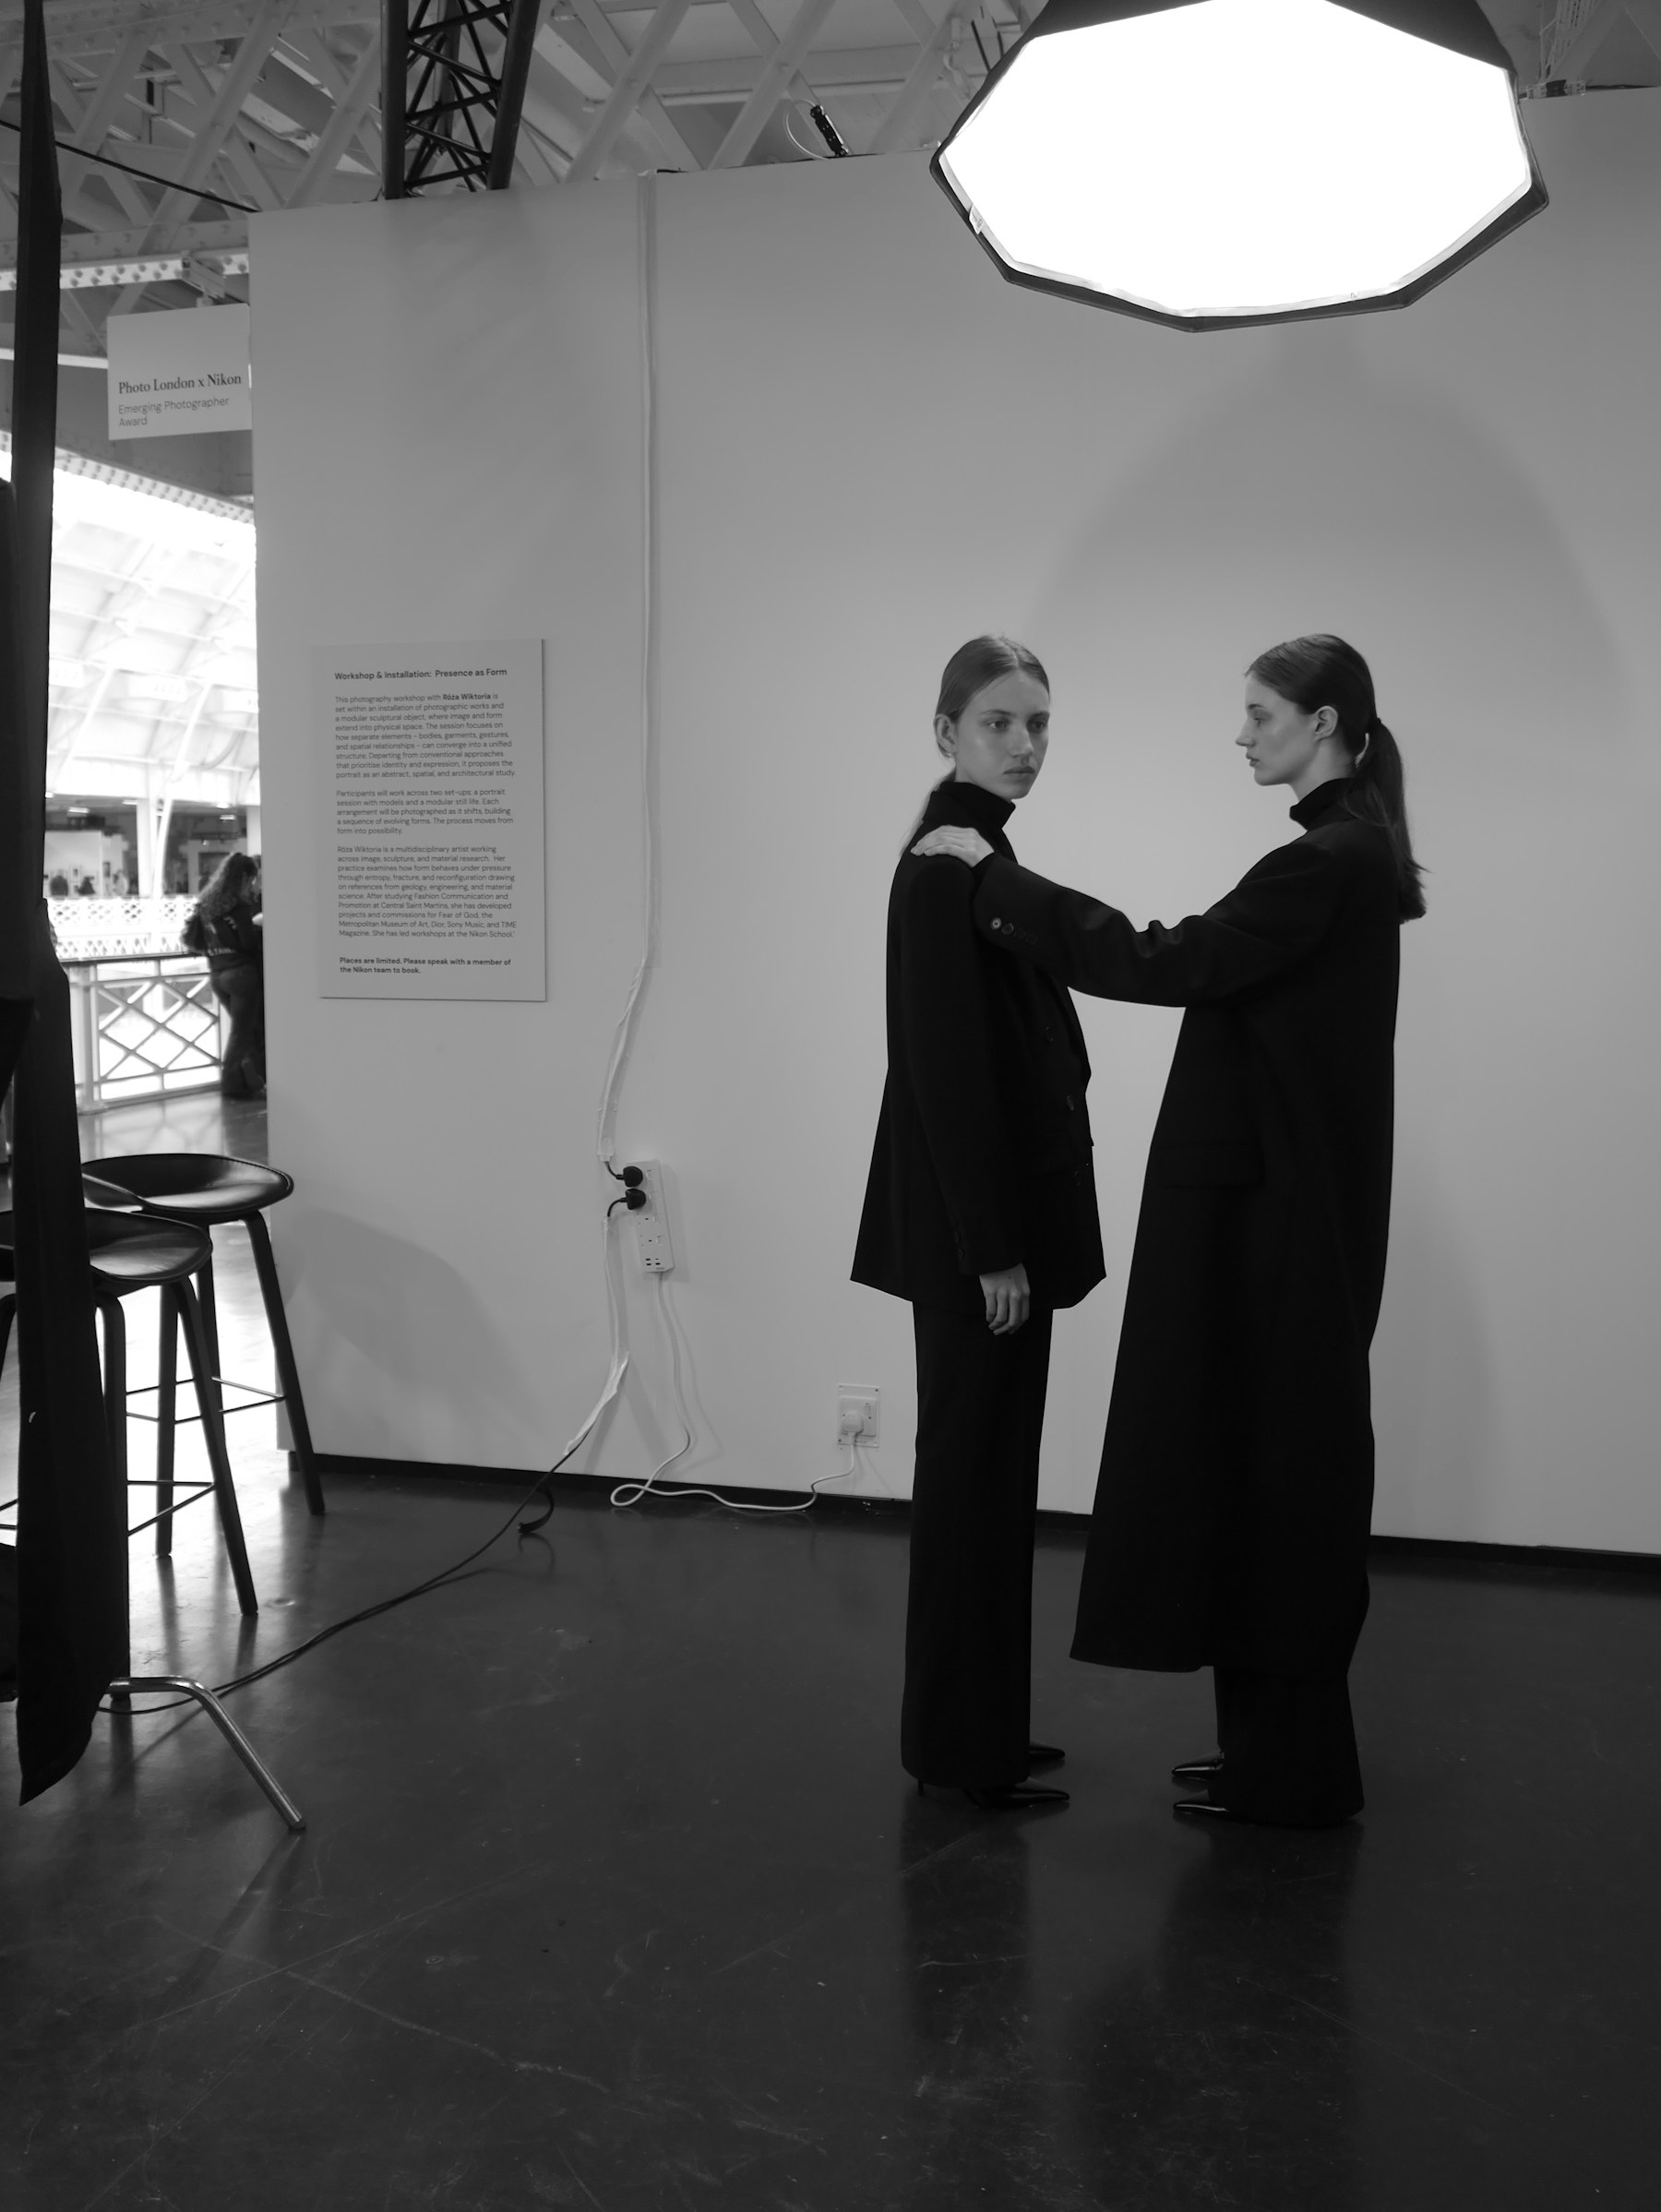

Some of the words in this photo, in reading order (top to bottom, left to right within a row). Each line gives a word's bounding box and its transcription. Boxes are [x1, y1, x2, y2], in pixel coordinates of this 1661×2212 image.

[119, 381, 150, 394] Photo
[153, 377, 195, 391] London
[197, 378, 205, 388] x
[207, 373, 242, 387] Nikon
[118, 402, 161, 414] Emerging
[164, 397, 229, 411] Photographer
[118, 416, 148, 427] Award
[335, 672, 375, 682] Workshop
[384, 670, 433, 679] Installation:
[435, 669, 473, 678] Presence
[485, 668, 508, 677] Form
[350, 695, 391, 704] photography
[393, 694, 425, 703] workshop
[368, 752, 401, 760] Departing
[464, 750, 504, 759] approaches
[336, 789, 376, 798] Participants
[479, 788, 506, 797] portrait
[337, 808, 378, 818] arrangement
[400, 808, 448, 817] photographed
[484, 808, 511, 817] building
[383, 818, 411, 826] evolving
[395, 845, 450, 855] multidisciplinary
[470, 845, 497, 855] working
[338, 865, 365, 874] practice
[338, 874, 364, 882] through
[436, 874, 487, 883] reconfiguration
[488, 874, 515, 883] drawing
[384, 892, 413, 902] studying
[477, 903, 512, 912] developed
[339, 912, 366, 920] projects
[339, 920, 380, 929] Metropolitan
[447, 921, 464, 929] Sony
[411, 930, 447, 939] workshops
[376, 957, 402, 965] limited.
[427, 958, 448, 967] speak
[472, 958, 502, 966] member
